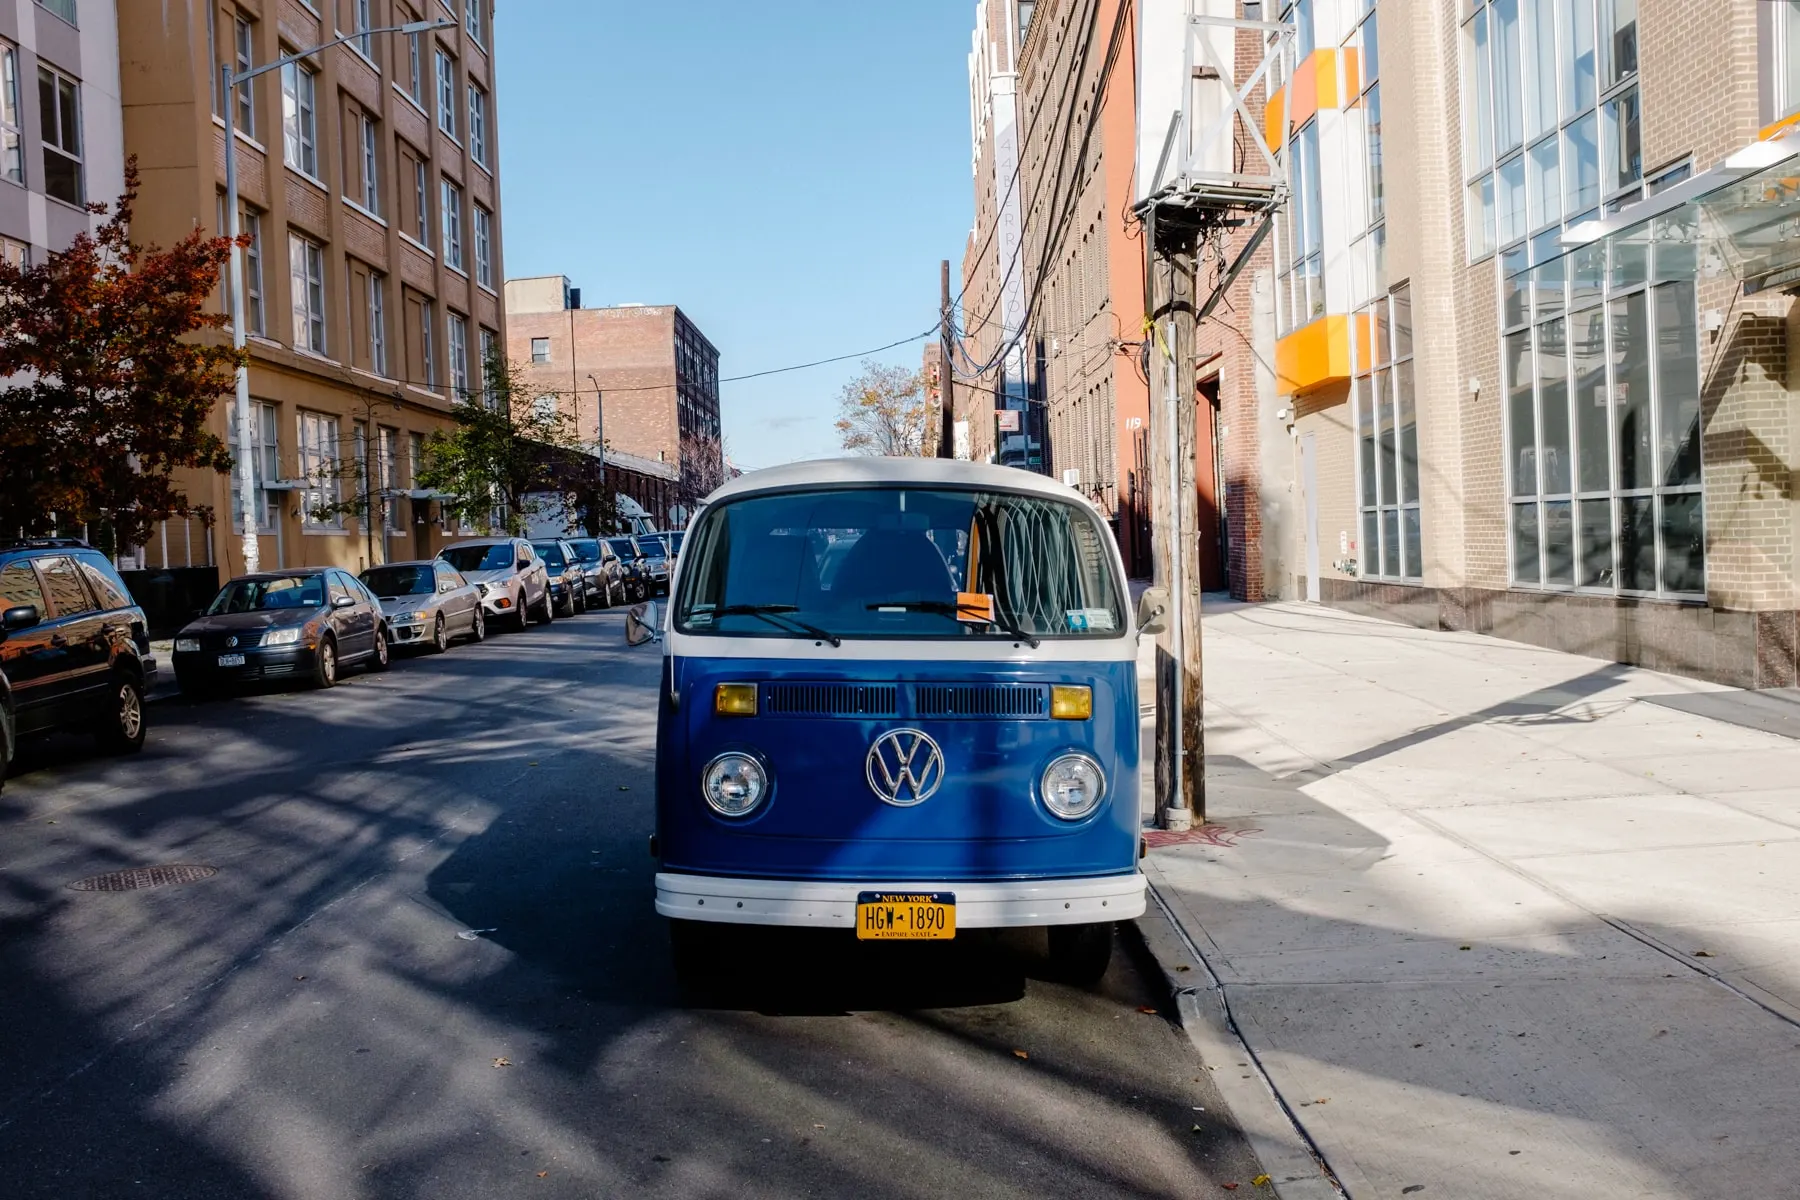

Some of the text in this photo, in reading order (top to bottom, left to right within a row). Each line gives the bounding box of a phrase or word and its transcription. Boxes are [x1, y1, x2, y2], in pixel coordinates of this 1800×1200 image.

[1125, 417, 1141, 430] 119
[867, 728, 944, 806] VW
[882, 895, 932, 903] NEW YORK
[866, 906, 945, 930] HGW 1890
